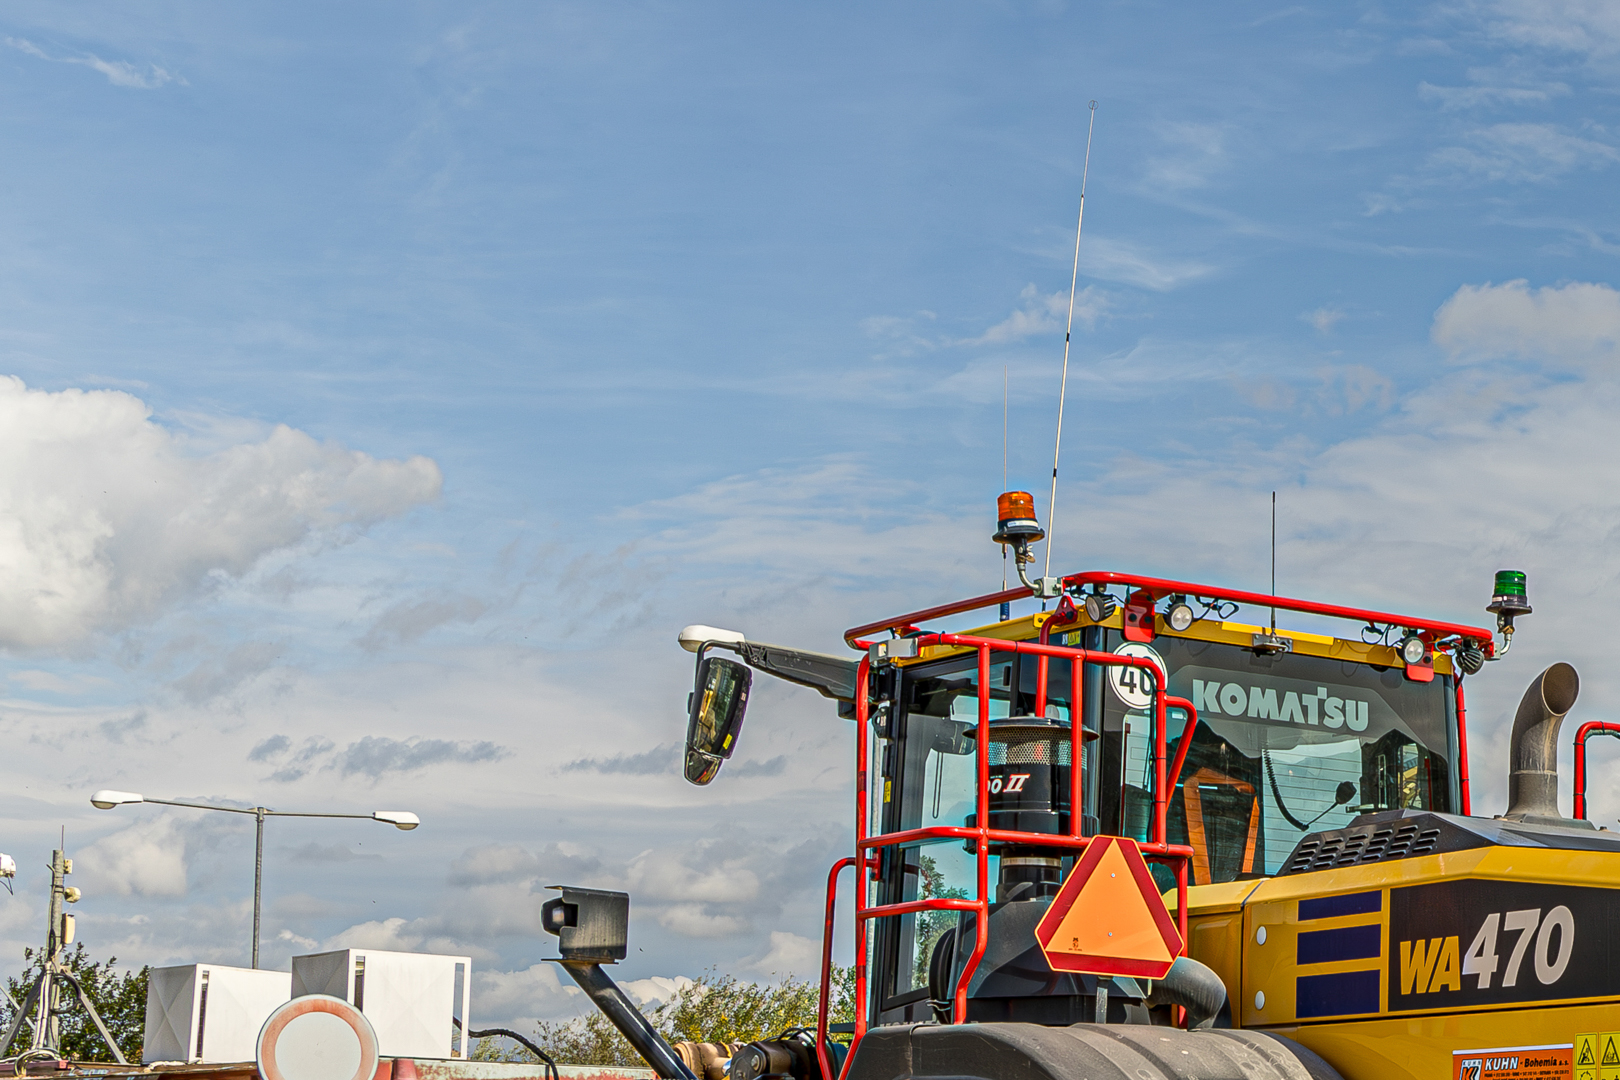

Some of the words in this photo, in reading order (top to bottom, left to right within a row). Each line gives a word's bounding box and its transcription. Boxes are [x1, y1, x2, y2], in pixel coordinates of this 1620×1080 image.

[1192, 679, 1369, 732] KOMATSU
[1485, 1056, 1519, 1071] KUHN
[1524, 1056, 1557, 1067] Bohemia
